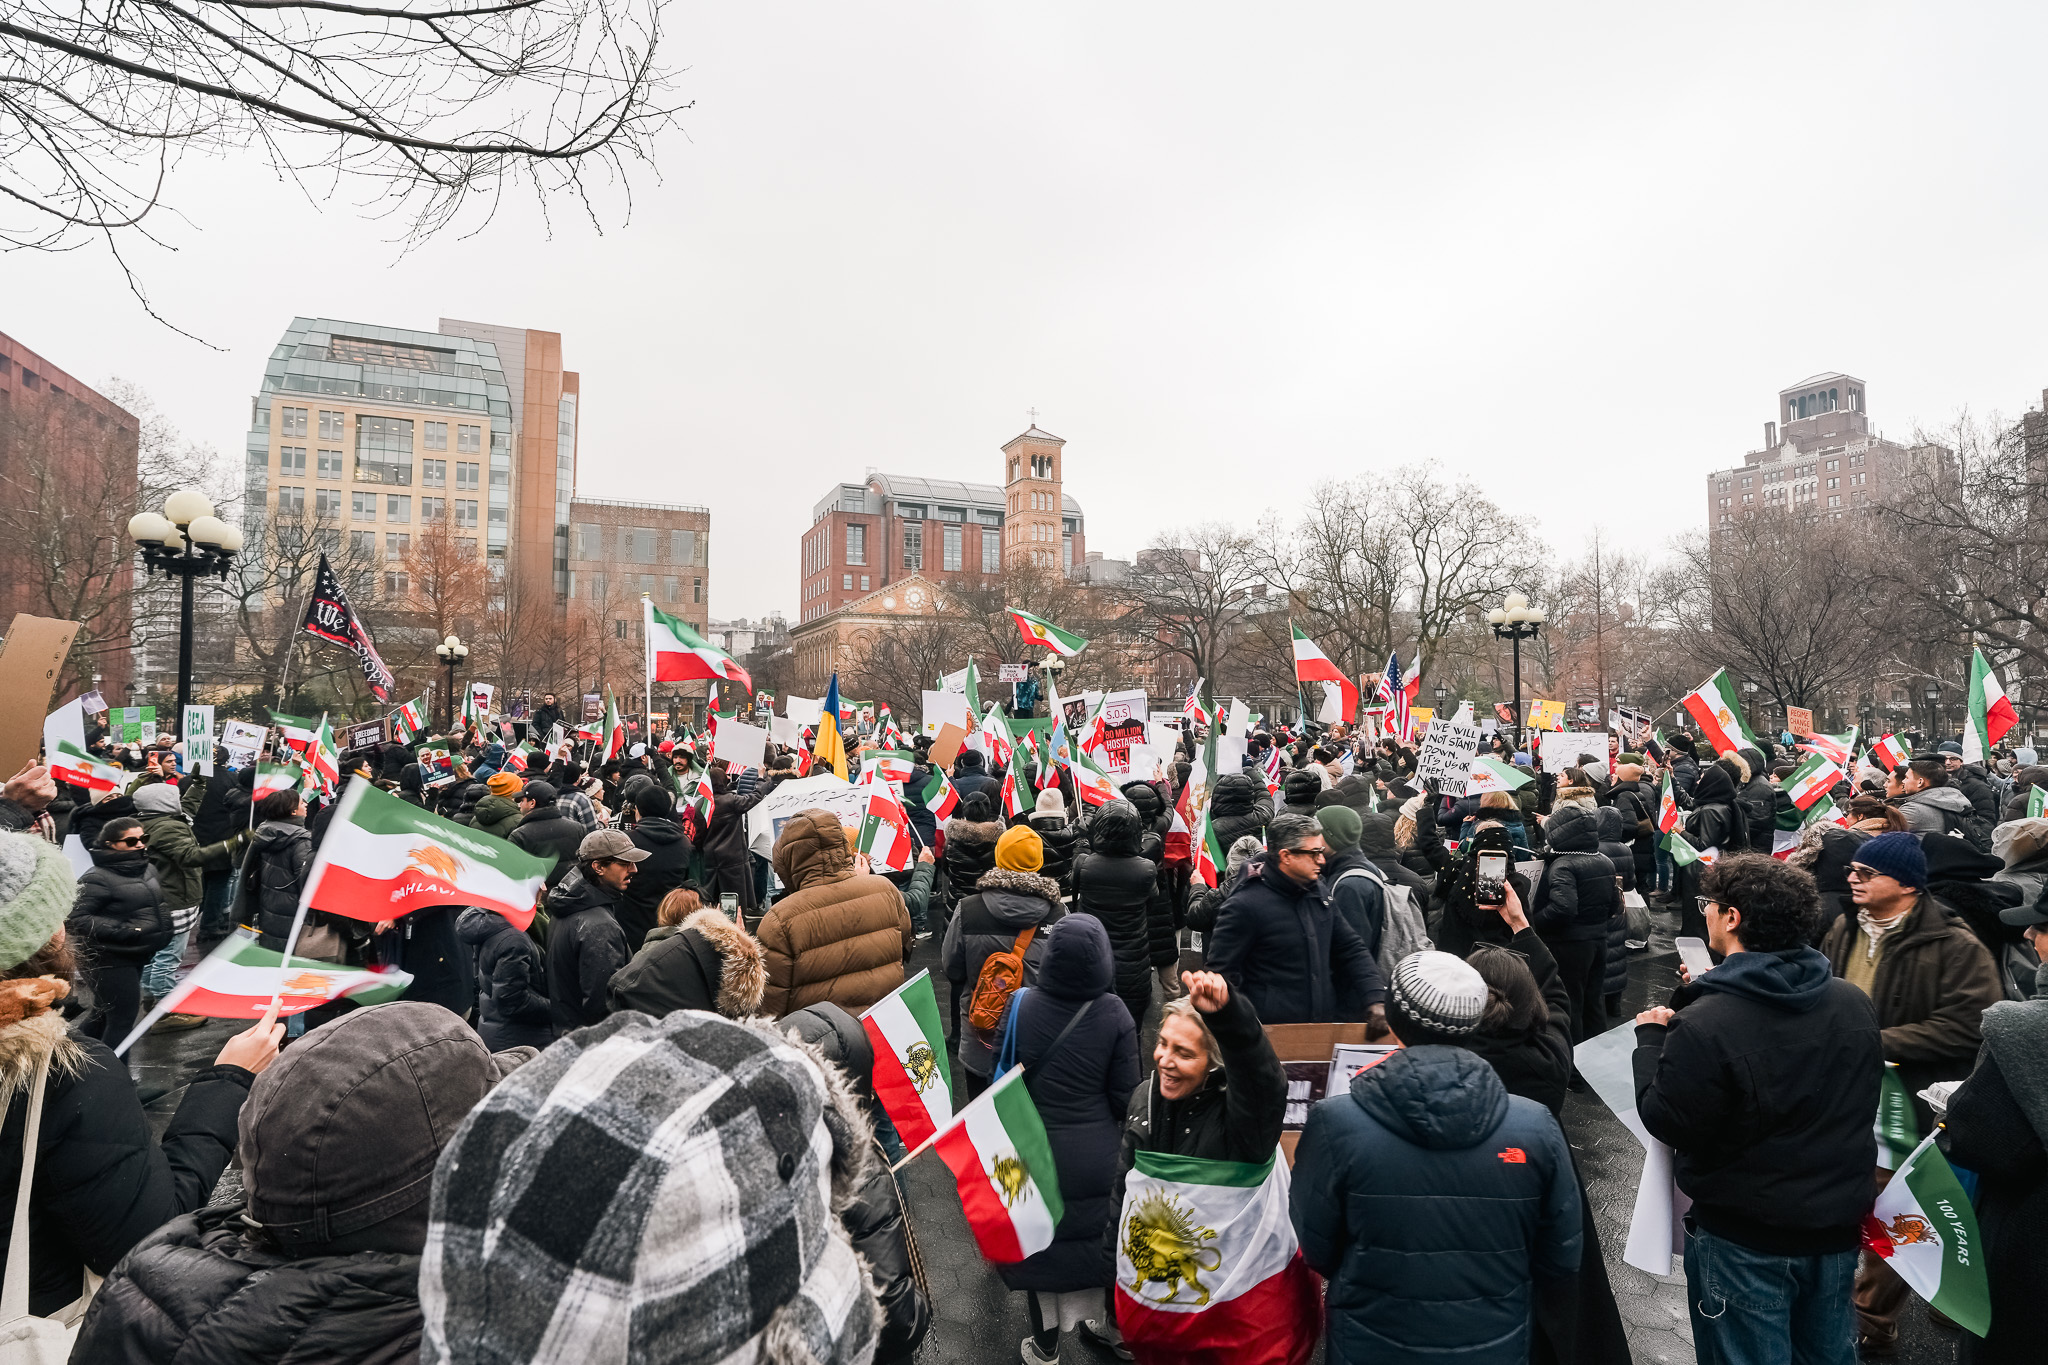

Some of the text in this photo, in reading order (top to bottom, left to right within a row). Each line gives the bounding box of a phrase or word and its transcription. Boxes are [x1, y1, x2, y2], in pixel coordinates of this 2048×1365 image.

[317, 600, 345, 632] We
[1106, 708, 1128, 720] S.O.S
[1790, 709, 1809, 720] REGIME
[187, 709, 206, 737] REZA
[1432, 721, 1476, 739] WE WILL
[1790, 717, 1810, 728] CHANGE
[1794, 726, 1809, 735] NOW!
[356, 734, 380, 747] FOR IRAN
[1104, 726, 1142, 739] 80 MILLION
[187, 739, 211, 761] PAHLAVI
[1106, 735, 1143, 750] HOSTAGES
[1428, 733, 1476, 752] NOT STAND
[1424, 744, 1459, 760] DOWN.
[1419, 764, 1447, 777] THEM.
[1423, 754, 1470, 773] IT'S US OR
[1890, 1092, 1904, 1108] 100
[1936, 1198, 1970, 1267] 100 YEARS
